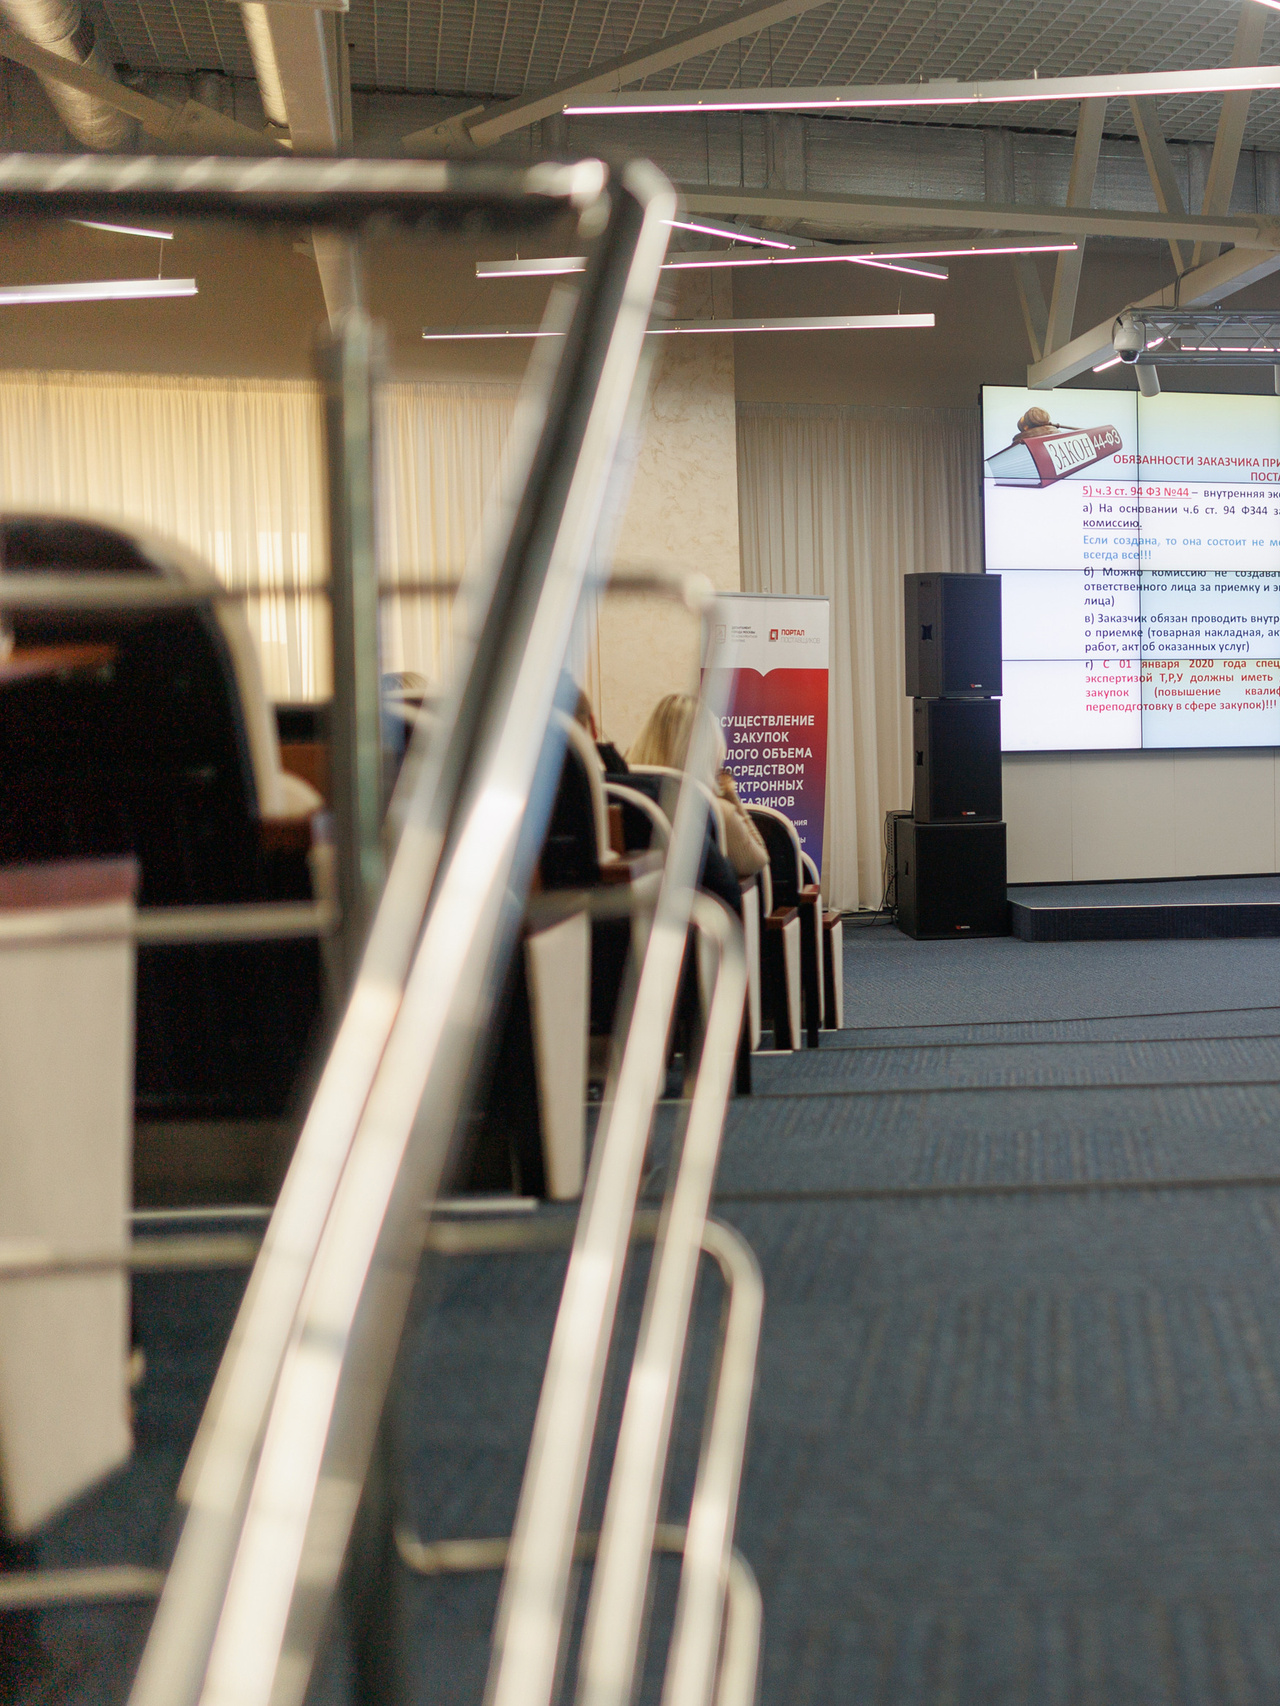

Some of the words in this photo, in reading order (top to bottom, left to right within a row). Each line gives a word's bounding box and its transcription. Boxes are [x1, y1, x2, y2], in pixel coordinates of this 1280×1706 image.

[1050, 436, 1095, 470] ЗАКОН
[1093, 430, 1121, 449] 44-ФЗ
[1113, 454, 1194, 466] ОБЯЗАННОСТИ
[1197, 456, 1259, 467] ЗАКАЗЧИКА
[1083, 486, 1093, 497] 5)
[1095, 486, 1111, 496] ч.3
[1114, 488, 1128, 496] ст.
[1130, 486, 1142, 496] 94
[1146, 486, 1160, 497] ФЗ
[1164, 487, 1189, 497] №44
[1203, 490, 1265, 500] внутренняя
[1083, 503, 1093, 515] а)
[1099, 504, 1113, 513] На
[1119, 506, 1178, 514] основании
[1183, 505, 1199, 515] ч.6
[1205, 507, 1217, 515] ст.
[1223, 505, 1235, 515] 94
[1241, 506, 1268, 516] ФЗ44
[1083, 519, 1142, 529] комиссию.
[1083, 535, 1108, 545] Если
[1113, 537, 1160, 548] создана,
[1166, 538, 1177, 546] то
[1182, 538, 1201, 546] она
[1207, 538, 1247, 546] состоит
[1252, 539, 1265, 547] не
[1083, 552, 1118, 560] всегда
[1121, 551, 1152, 560] все!!!
[1102, 567, 1144, 577] Можно
[1084, 583, 1167, 592] ответственного
[1170, 583, 1197, 592] лица
[1200, 583, 1211, 591] за
[1214, 583, 1260, 593] приемку
[1084, 596, 1115, 606] лица)
[1085, 613, 1095, 624] в)
[1098, 613, 1147, 623] Заказчик
[1150, 613, 1188, 623] обязан
[1191, 615, 1247, 625] проводить
[1095, 629, 1143, 639] приемке
[1147, 627, 1201, 639] (товарная
[1204, 629, 1264, 638] накладная,
[1085, 642, 1119, 653] работ,
[1142, 642, 1155, 651] об
[1219, 641, 1250, 653] услуг)
[1085, 660, 1093, 670] г)
[1119, 660, 1132, 669] 01
[1141, 661, 1180, 669] января
[1189, 659, 1214, 668] 2020
[1223, 661, 1247, 669] года
[1085, 674, 1153, 684] экспертизой
[1159, 674, 1183, 683] Т,Р,У
[1189, 673, 1234, 683] должны
[1241, 674, 1273, 682] иметь
[1085, 689, 1129, 698] закупок
[1154, 687, 1221, 698] (повышение
[1086, 702, 1173, 713] переподготовку
[1184, 702, 1217, 712] сфере
[1219, 700, 1277, 710] закупок)!!!
[733, 731, 789, 744] ЗАКУПОК
[727, 748, 759, 761] ЛОГО
[762, 747, 813, 759] ОБЪЕМА
[726, 764, 804, 777] ОСРЕДСТВОМ
[734, 780, 804, 793] ЕКТРОННЫХ
